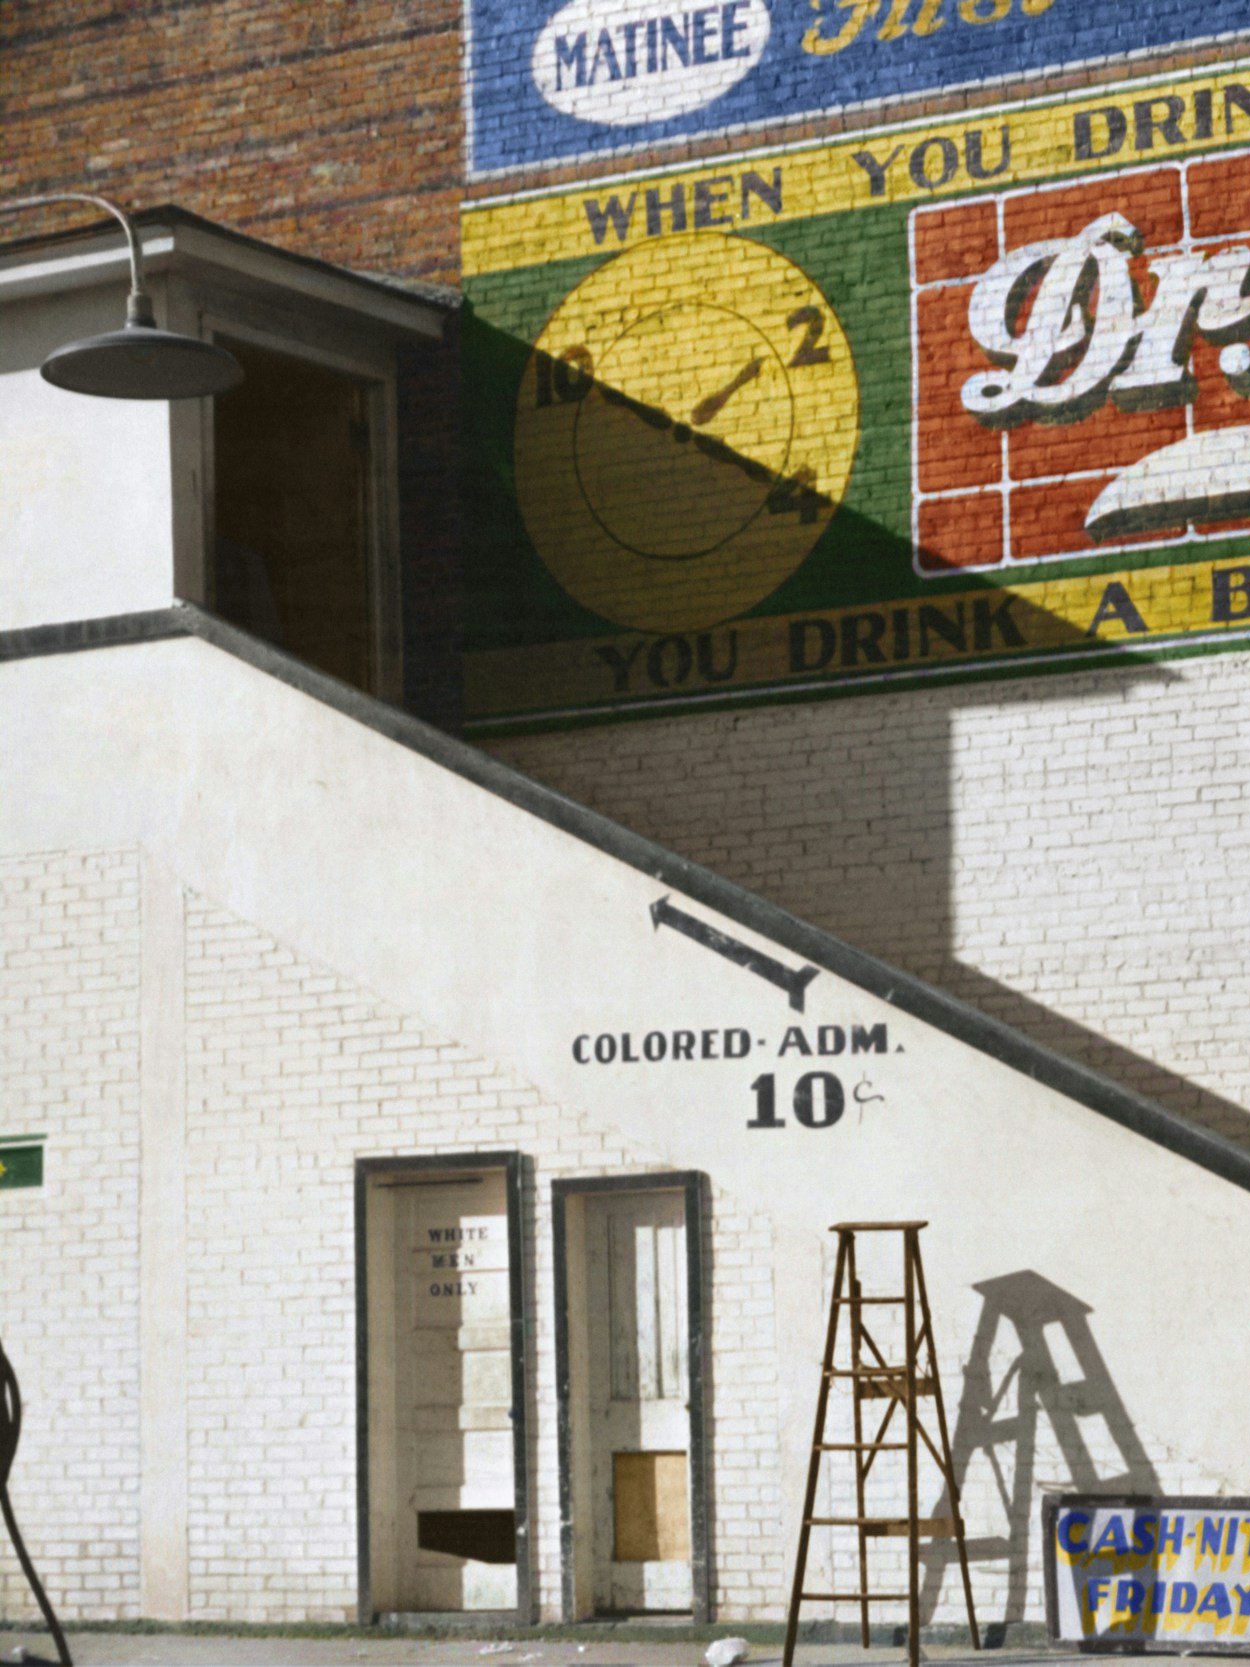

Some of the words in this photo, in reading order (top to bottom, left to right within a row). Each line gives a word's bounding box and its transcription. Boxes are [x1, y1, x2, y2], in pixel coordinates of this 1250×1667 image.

[554, 2, 751, 91] MATINEE
[583, 166, 783, 246] WHEN
[852, 124, 1012, 196] YOU
[786, 305, 831, 367] 2
[536, 344, 594, 409] 10
[766, 465, 834, 524] 4
[595, 628, 737, 692] YOU
[789, 594, 1027, 674] DRINK
[1085, 581, 1149, 640] A
[777, 1023, 906, 1057] ADM.
[428, 1227, 488, 1242] WHITE
[432, 1253, 474, 1268] MEN
[430, 1282, 477, 1297] ONLY
